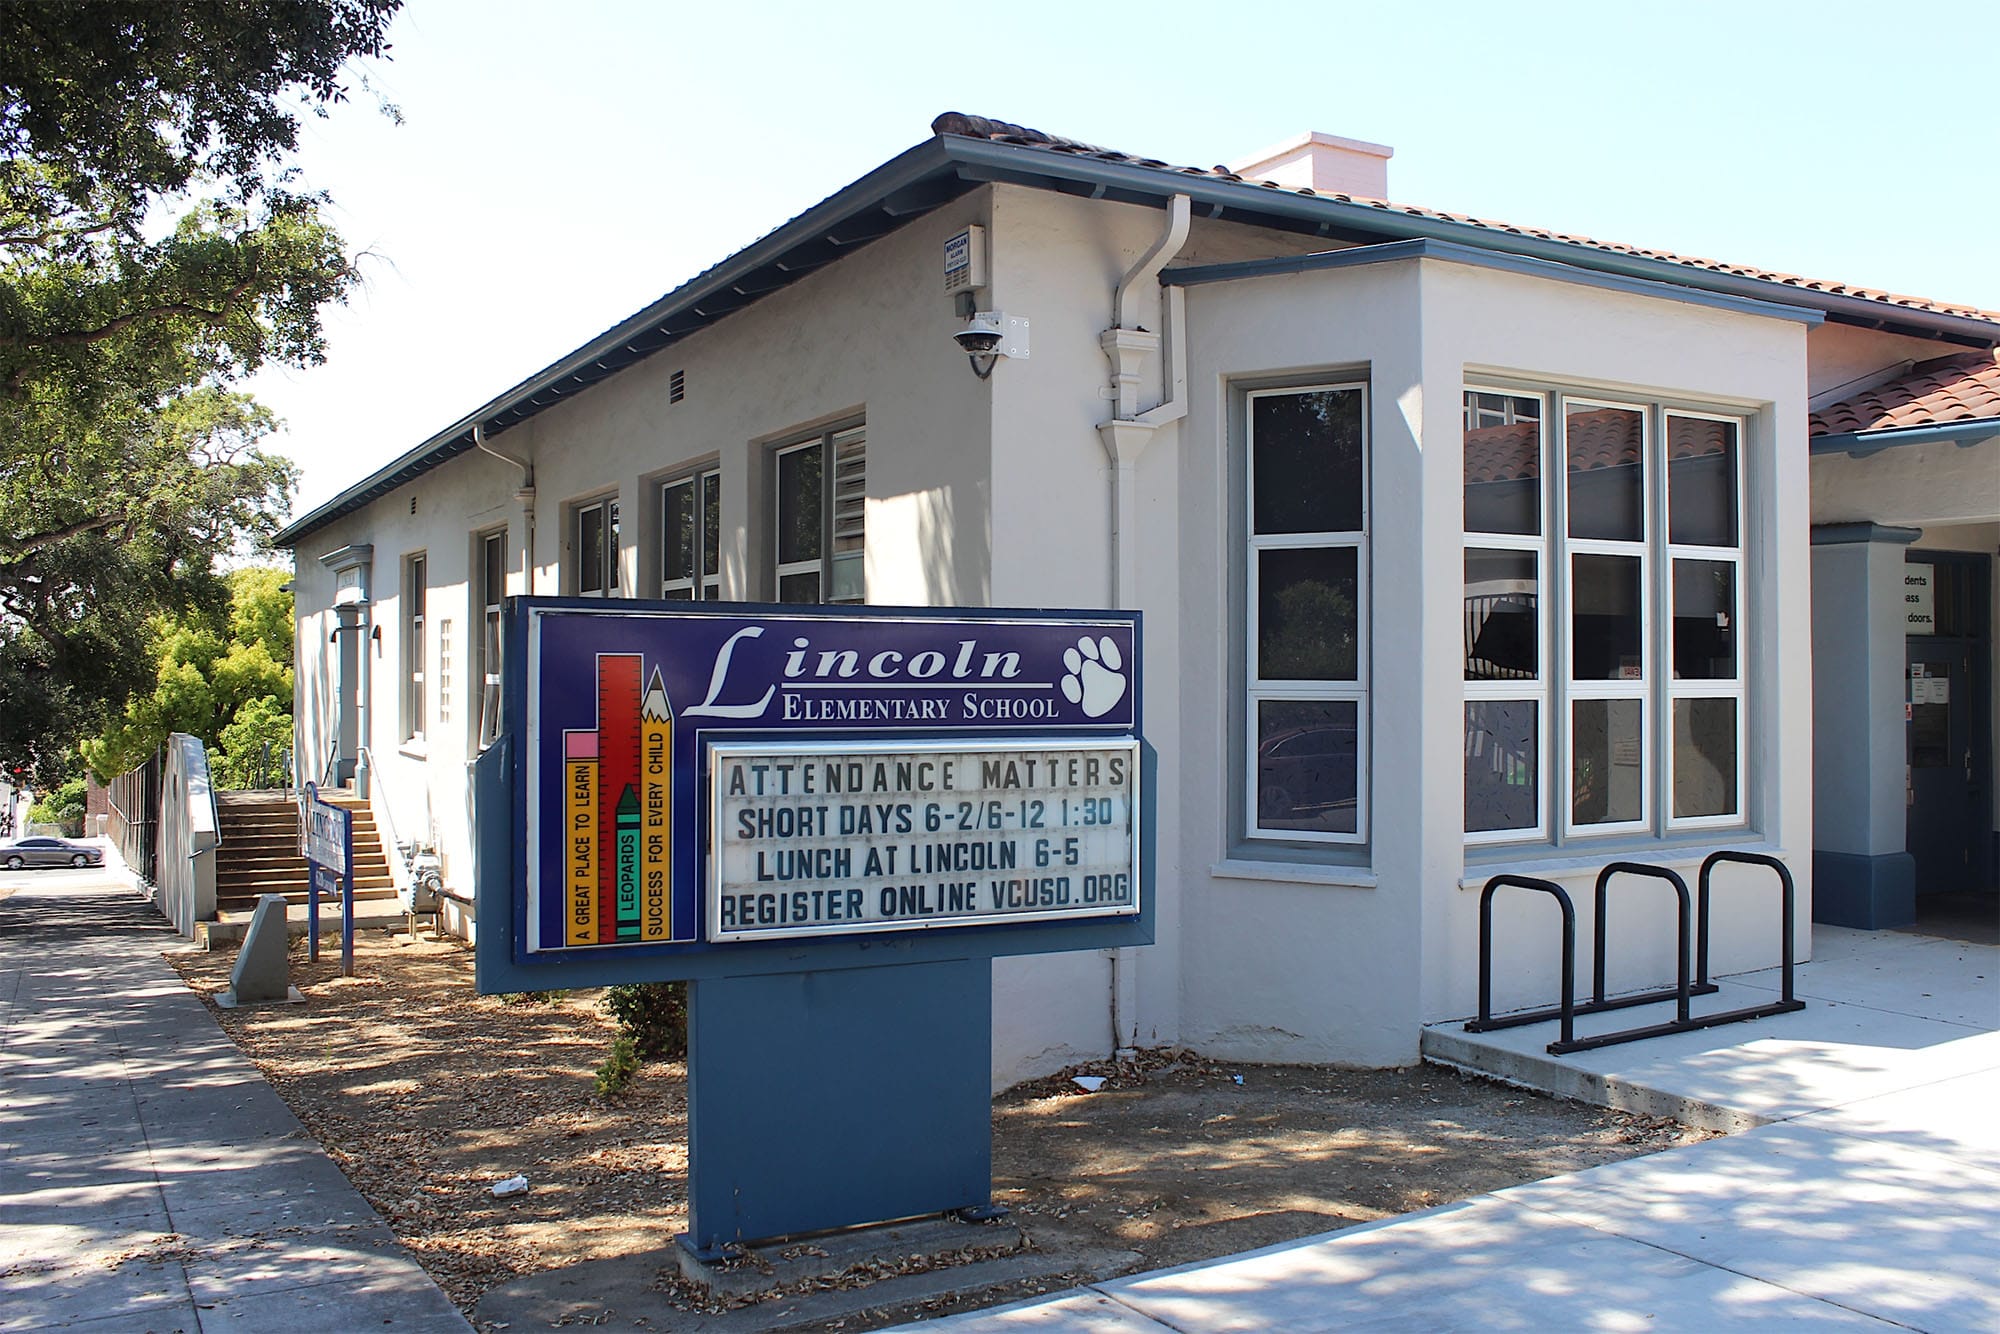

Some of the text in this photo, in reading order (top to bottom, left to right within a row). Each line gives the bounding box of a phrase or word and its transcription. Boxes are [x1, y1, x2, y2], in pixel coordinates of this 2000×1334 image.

[946, 238, 967, 253] MORGAN
[680, 626, 1022, 719] Lincoln
[781, 692, 1059, 720] ELEMENTARY SCHOOL
[729, 758, 1124, 796] ATTENDANCE MATTERS
[648, 732, 663, 936] SUCCESS FOR EVERY CHILD
[738, 797, 1112, 839] SHORT DAYS 6-2/6-12 1:30
[575, 765, 590, 940] A GREAT PLACE TO LEARN
[621, 834, 635, 912] LEOPARDS
[757, 838, 1079, 881] LUNCH AT LINCOLN 6-5
[720, 873, 1127, 925] REGISTER ONLINE VCUSD.ORG
